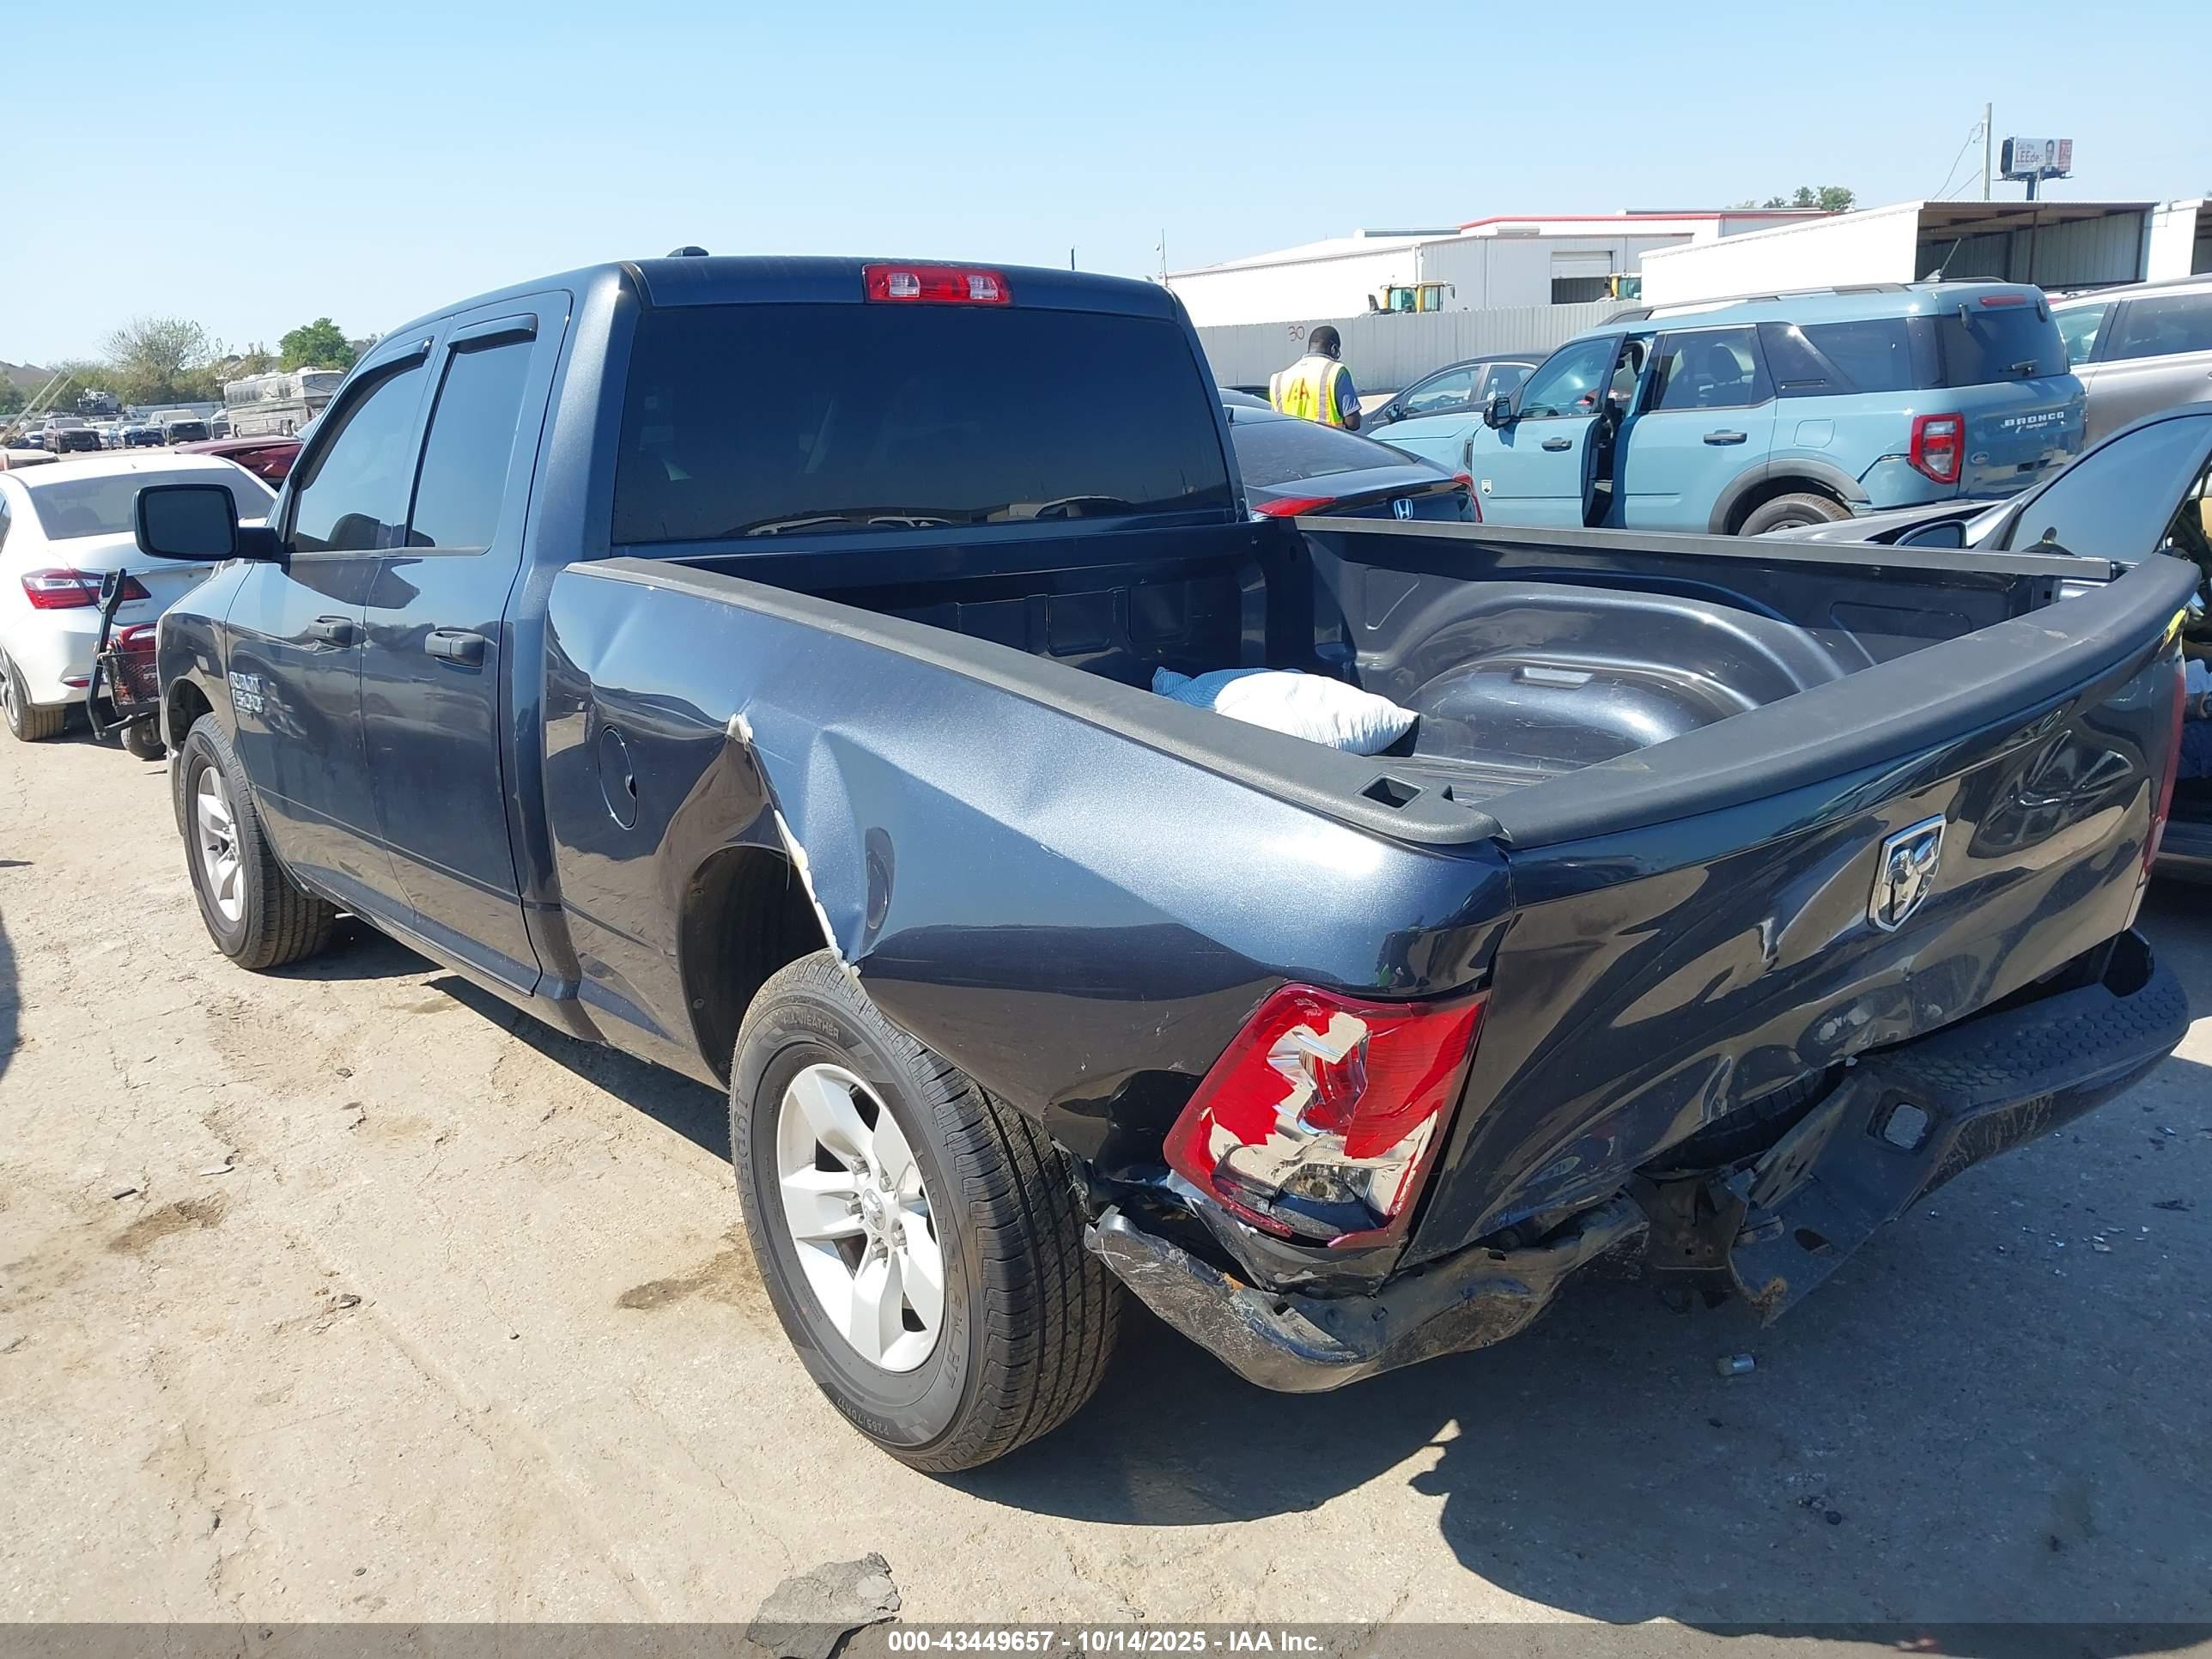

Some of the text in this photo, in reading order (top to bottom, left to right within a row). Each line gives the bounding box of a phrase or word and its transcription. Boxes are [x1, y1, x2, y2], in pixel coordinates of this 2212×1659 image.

[1288, 325, 1305, 342] 30
[2004, 411, 2064, 427] BRONCO
[798, 1012, 840, 1041] WEATHER
